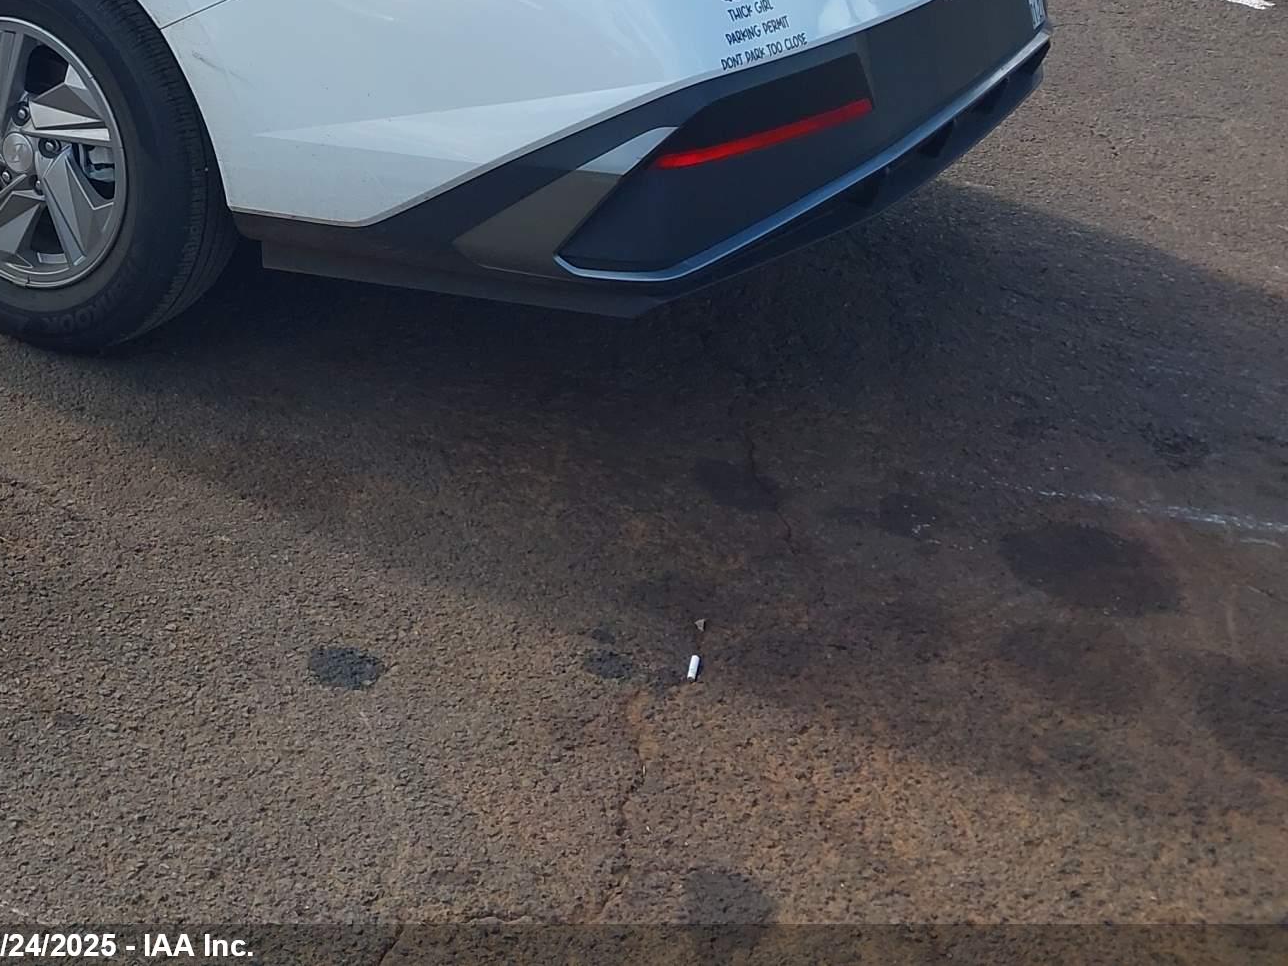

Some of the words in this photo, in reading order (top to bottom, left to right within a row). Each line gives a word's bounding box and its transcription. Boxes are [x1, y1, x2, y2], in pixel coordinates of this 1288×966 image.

[727, 4, 753, 22] THICK
[725, 25, 762, 46] PARKING
[762, 15, 790, 35] PERMIT
[721, 53, 744, 71] DONT
[744, 46, 766, 64] PARK
[766, 41, 783, 57] TOO
[784, 32, 808, 51] CLOSE
